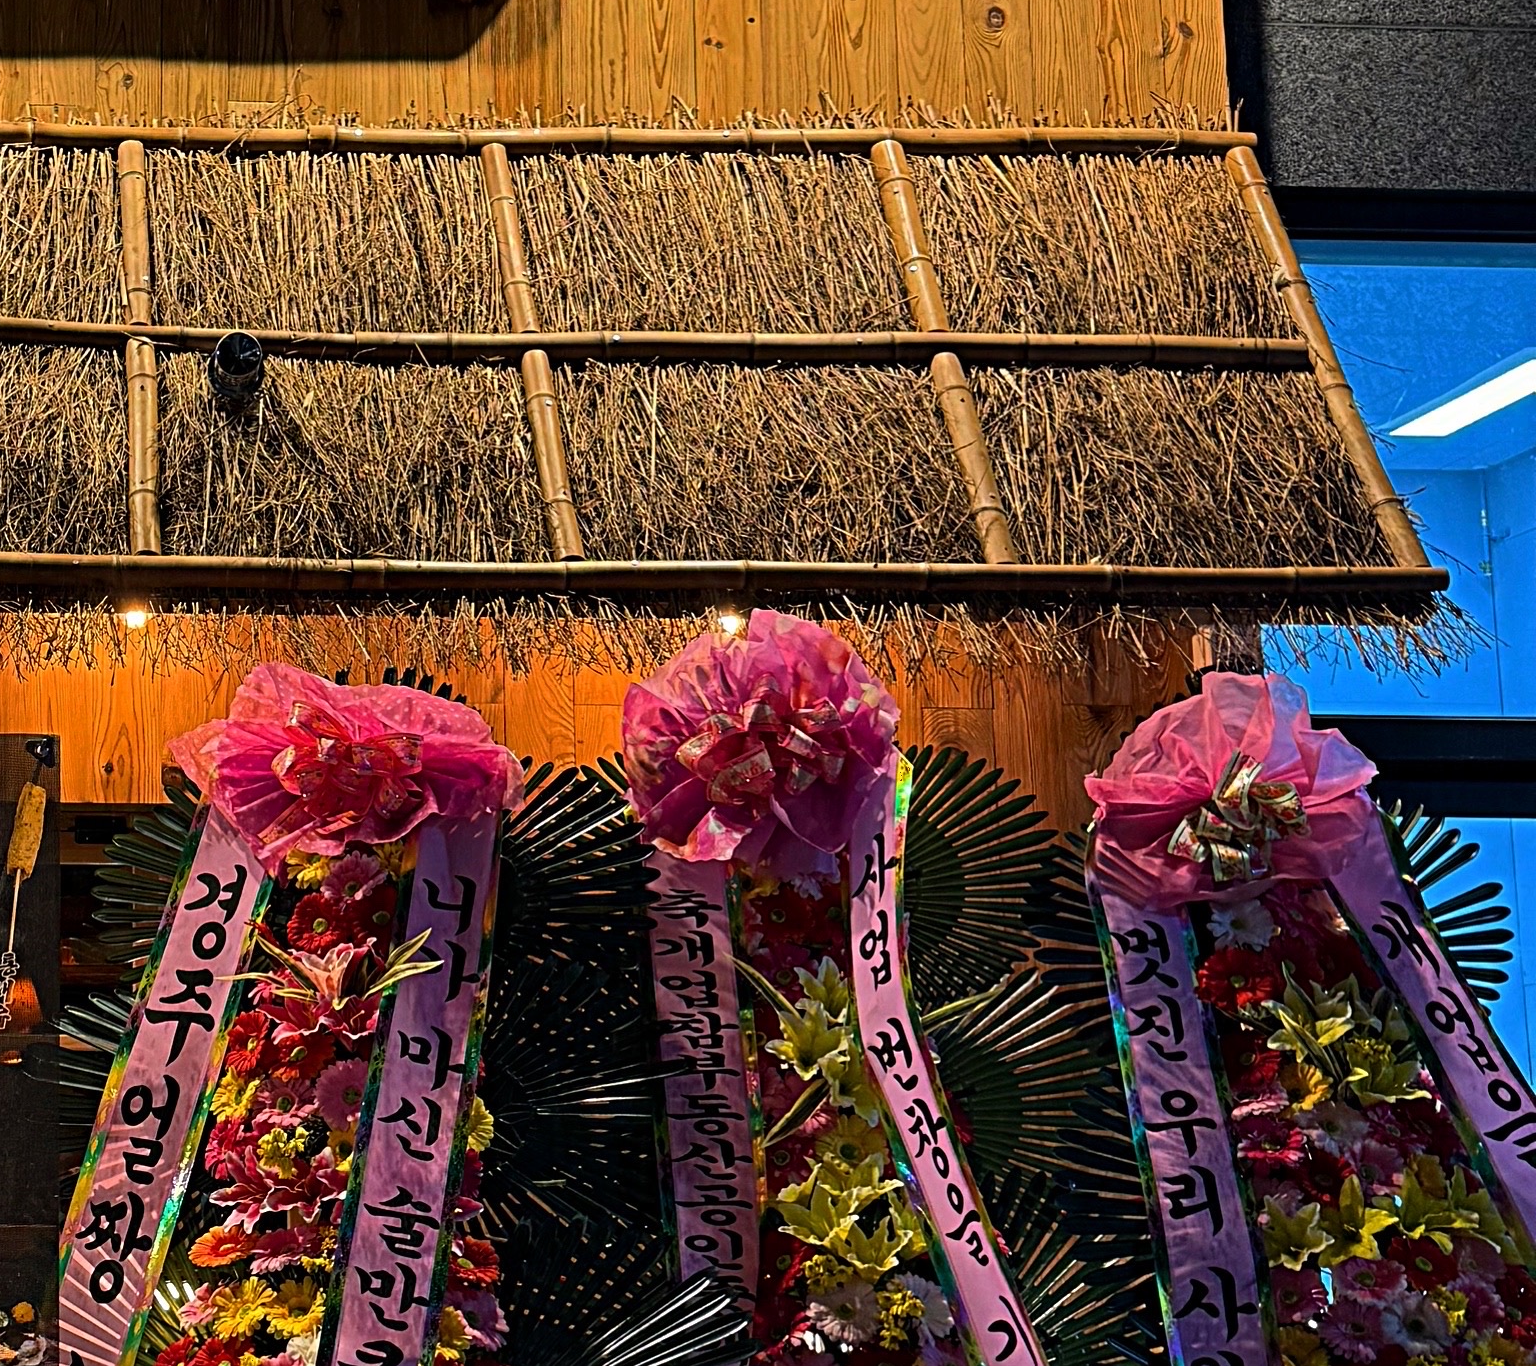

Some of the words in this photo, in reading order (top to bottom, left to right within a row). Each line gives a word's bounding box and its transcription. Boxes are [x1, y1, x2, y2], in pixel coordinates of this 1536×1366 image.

[852, 832, 897, 991] 사업
[1109, 920, 1189, 1062] 멋진
[377, 1026, 465, 1162] 마신
[867, 1017, 989, 1267] 번창을
[1144, 1088, 1222, 1237] 우리
